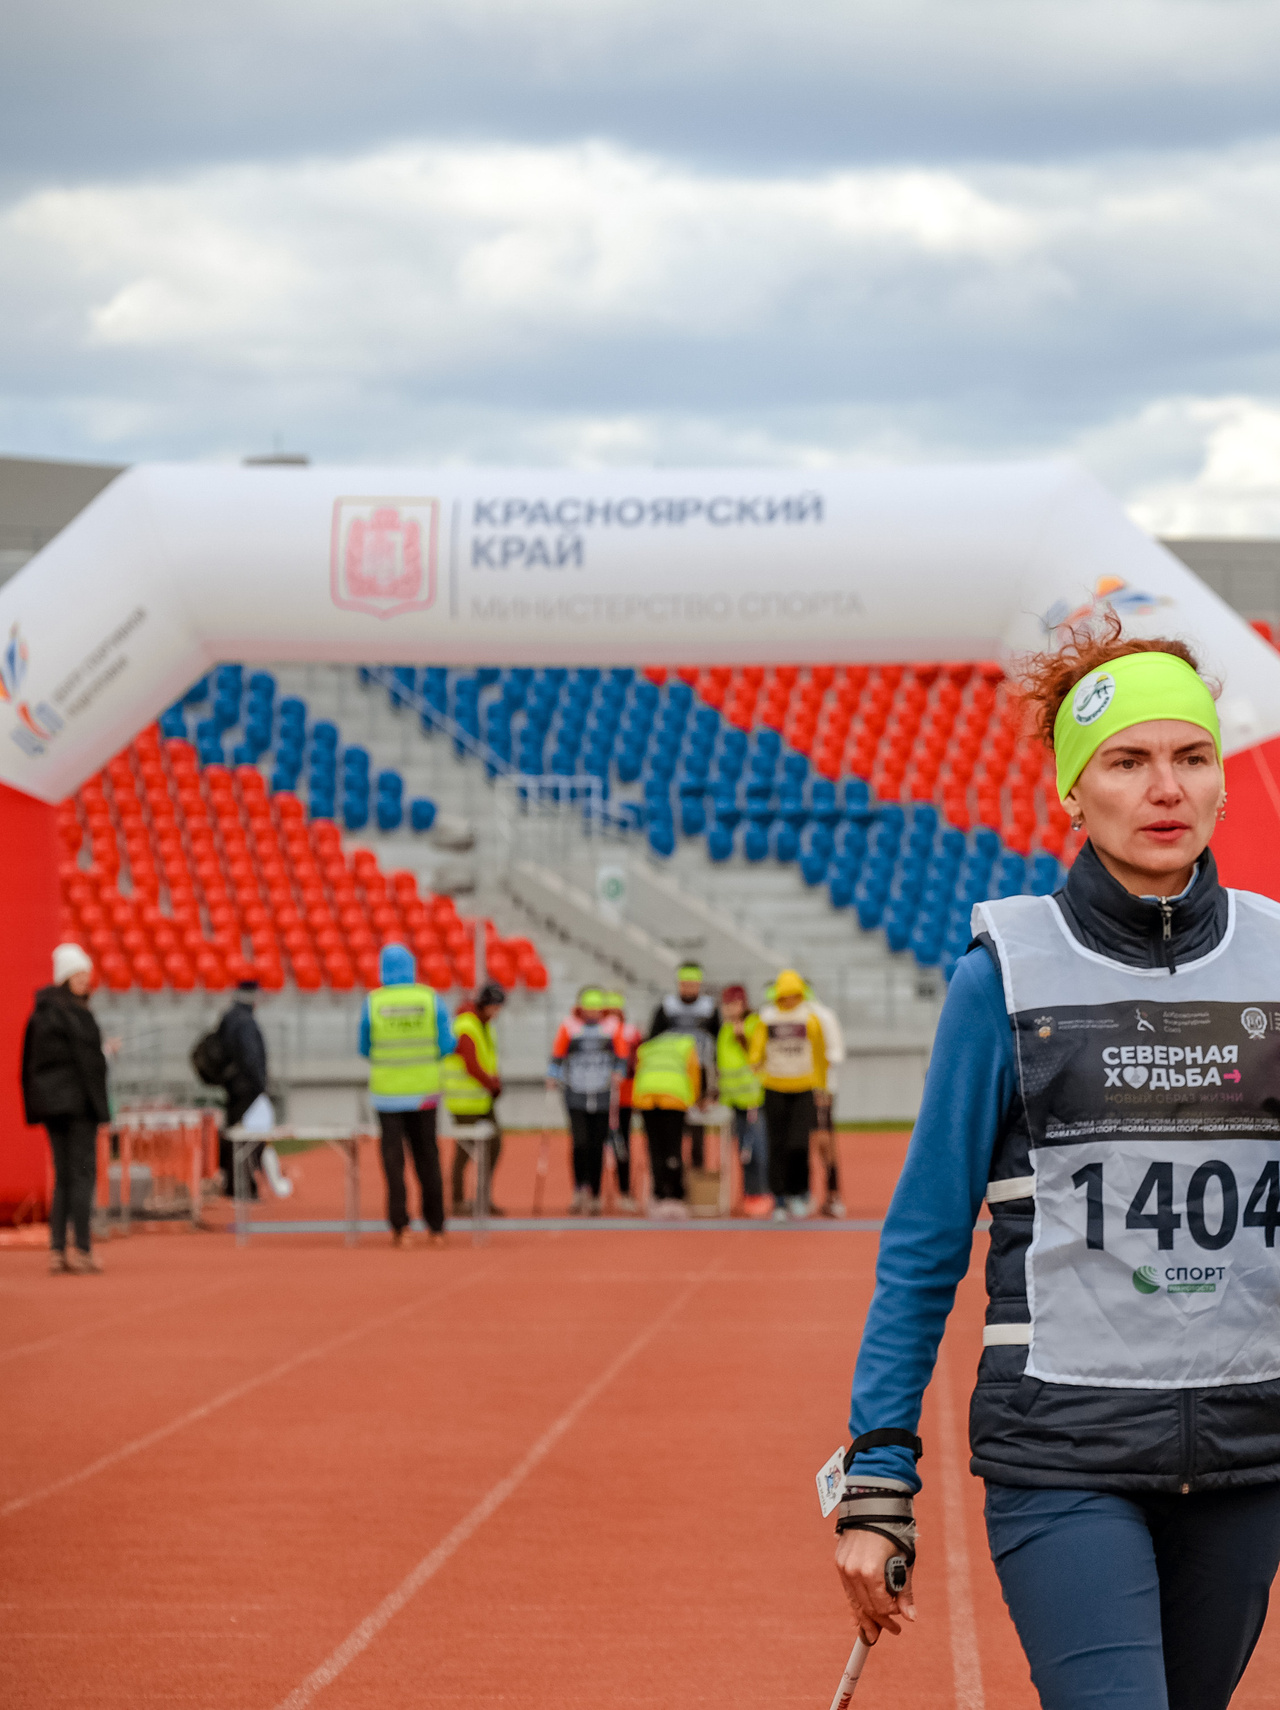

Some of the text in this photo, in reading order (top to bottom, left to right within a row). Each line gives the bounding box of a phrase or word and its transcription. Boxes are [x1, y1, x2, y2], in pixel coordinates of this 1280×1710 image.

[473, 490, 825, 528] КРАСНОЯРСКИЙ
[471, 525, 586, 569] КРАЙ
[1102, 1045, 1239, 1066] СЕВЕРНАЯ
[1165, 1267, 1226, 1280] СПОРТ
